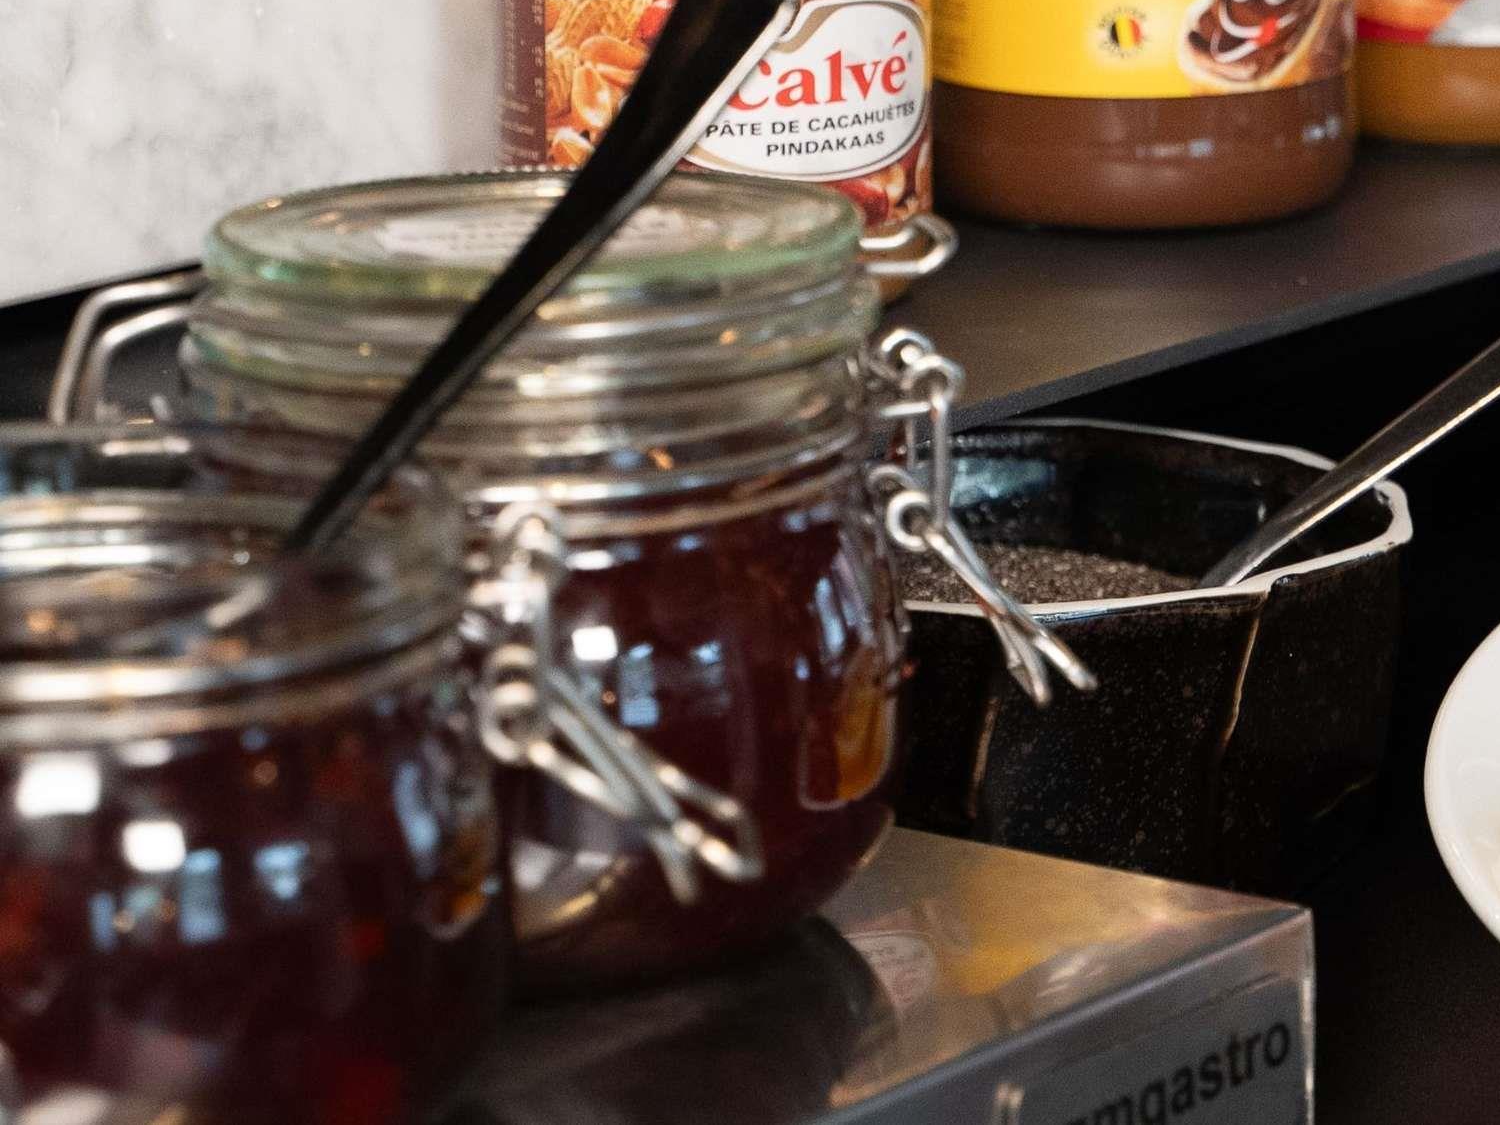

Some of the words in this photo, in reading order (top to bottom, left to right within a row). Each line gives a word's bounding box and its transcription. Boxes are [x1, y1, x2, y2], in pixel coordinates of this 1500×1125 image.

[705, 118, 762, 138] PÂTE
[771, 119, 800, 135] DE
[766, 131, 886, 158] PINDAKAAS
